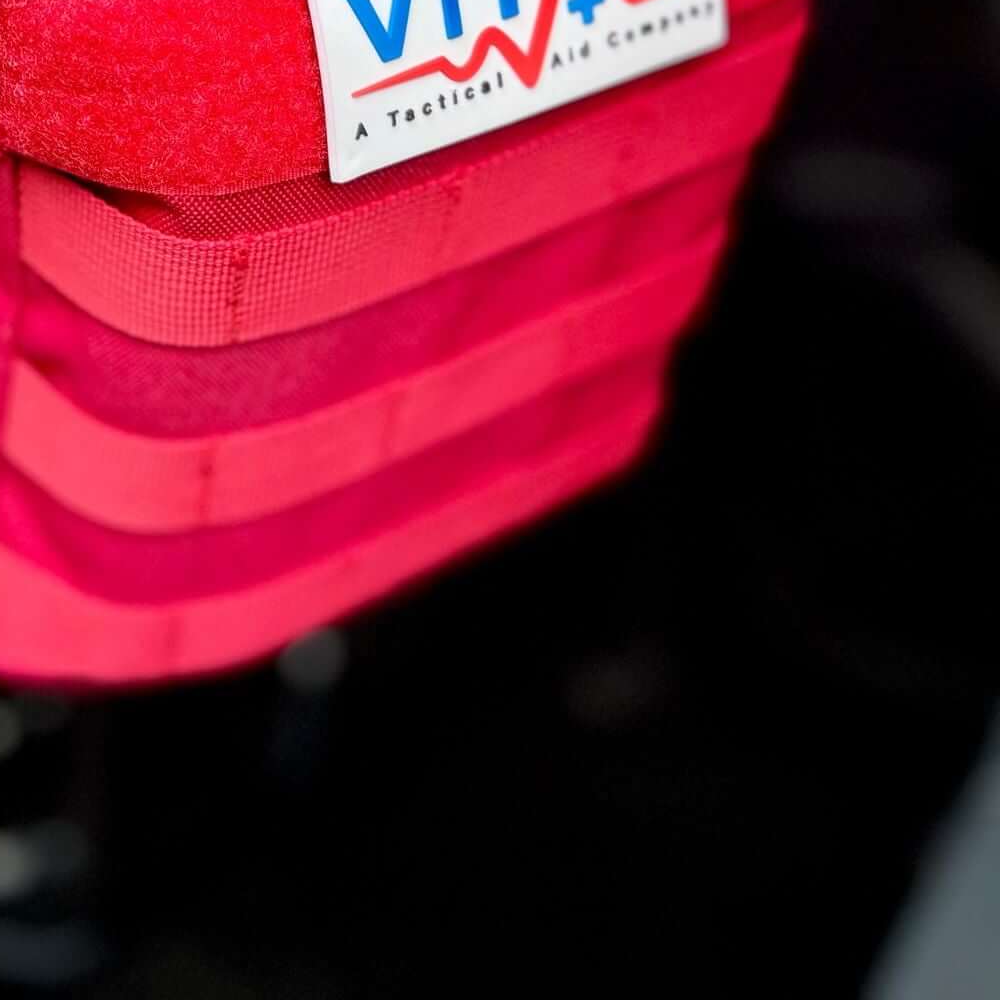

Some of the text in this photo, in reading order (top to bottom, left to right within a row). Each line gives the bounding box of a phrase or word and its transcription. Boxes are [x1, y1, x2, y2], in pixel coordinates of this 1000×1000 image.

[355, 0, 715, 142] A Tactical Aid Company
